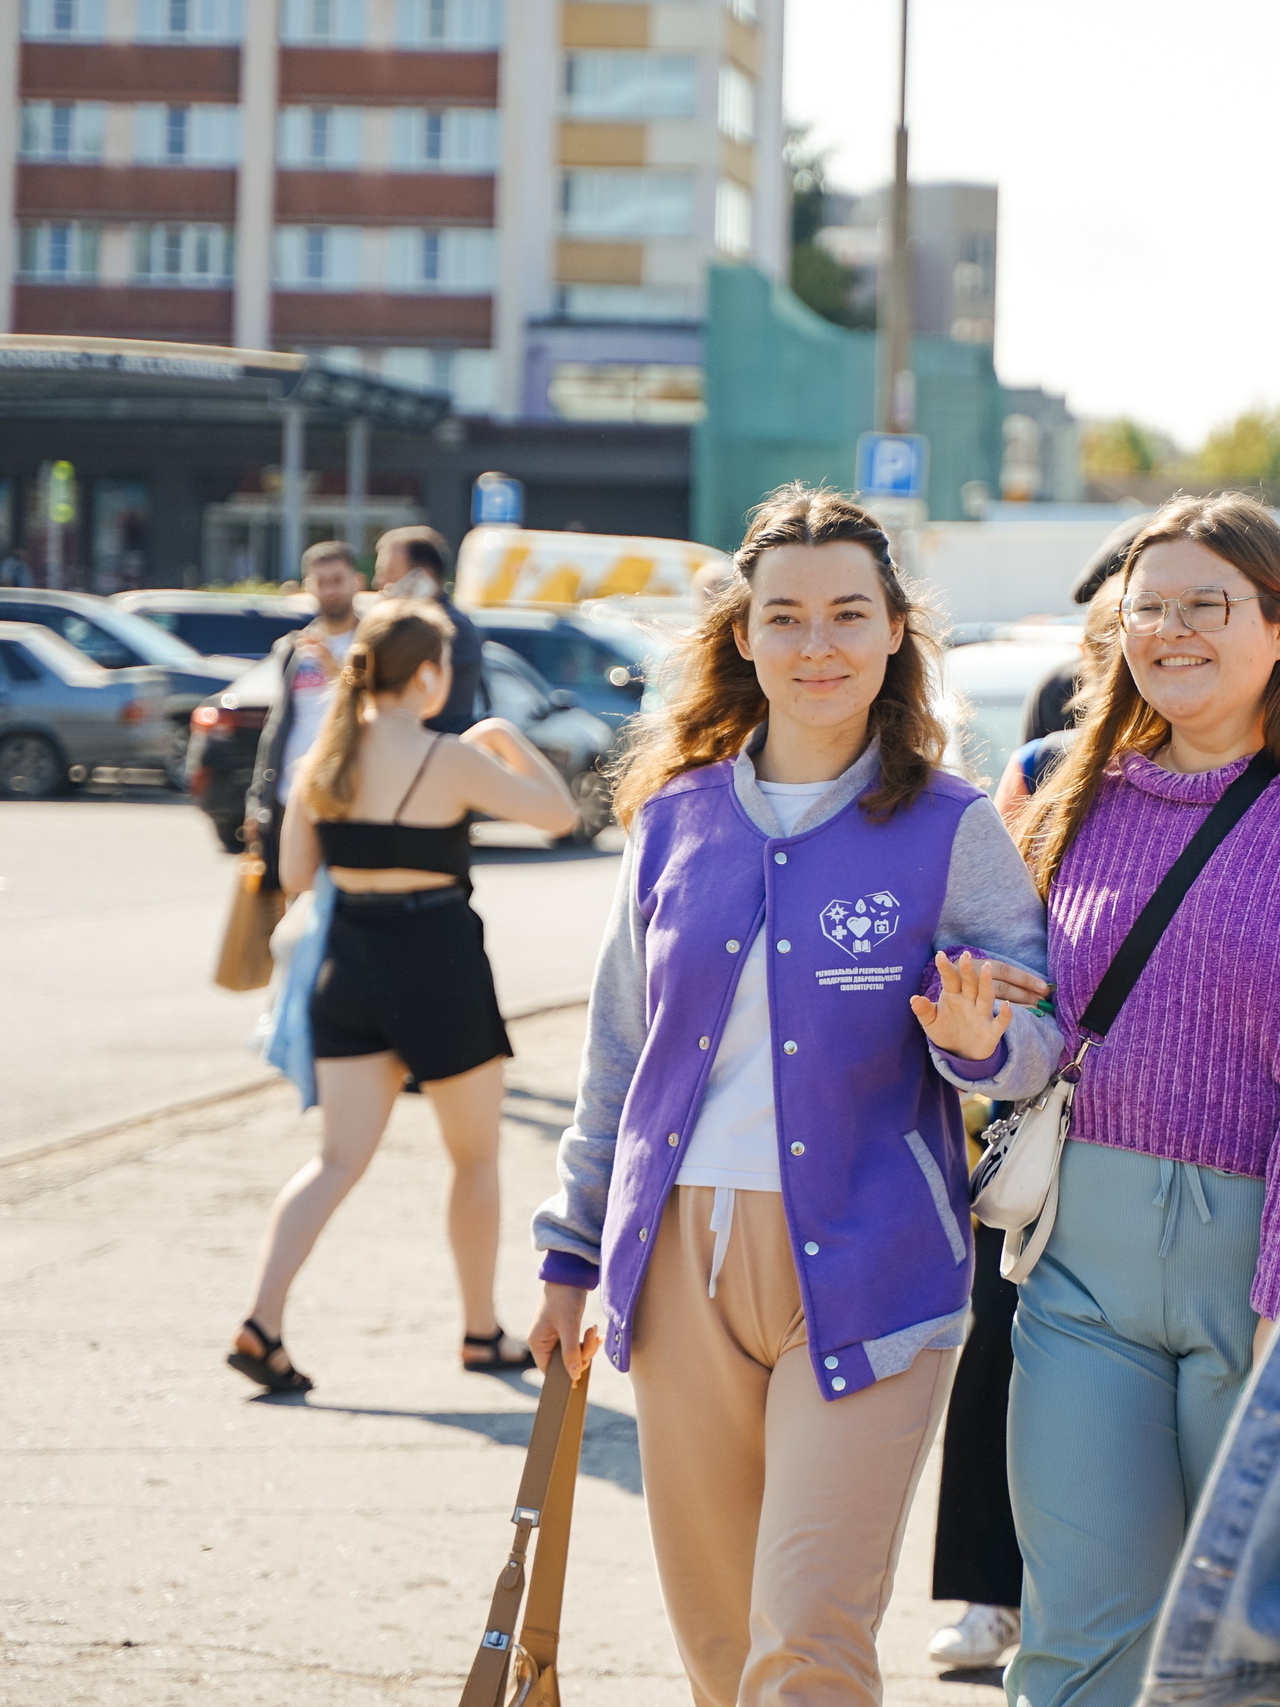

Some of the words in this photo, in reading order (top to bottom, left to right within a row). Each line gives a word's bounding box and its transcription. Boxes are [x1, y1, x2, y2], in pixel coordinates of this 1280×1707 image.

[874, 440, 917, 484] P
[815, 967, 858, 978] РЕГИОНАЛЬНЫЙ
[859, 966, 889, 975] РЕСУРСНЫЙ
[890, 966, 903, 974] ЦЕНТР
[819, 976, 852, 985] ПОДДЕРЖКИ
[853, 974, 901, 983] ДОБРОВОЛЬЧЕСТВА
